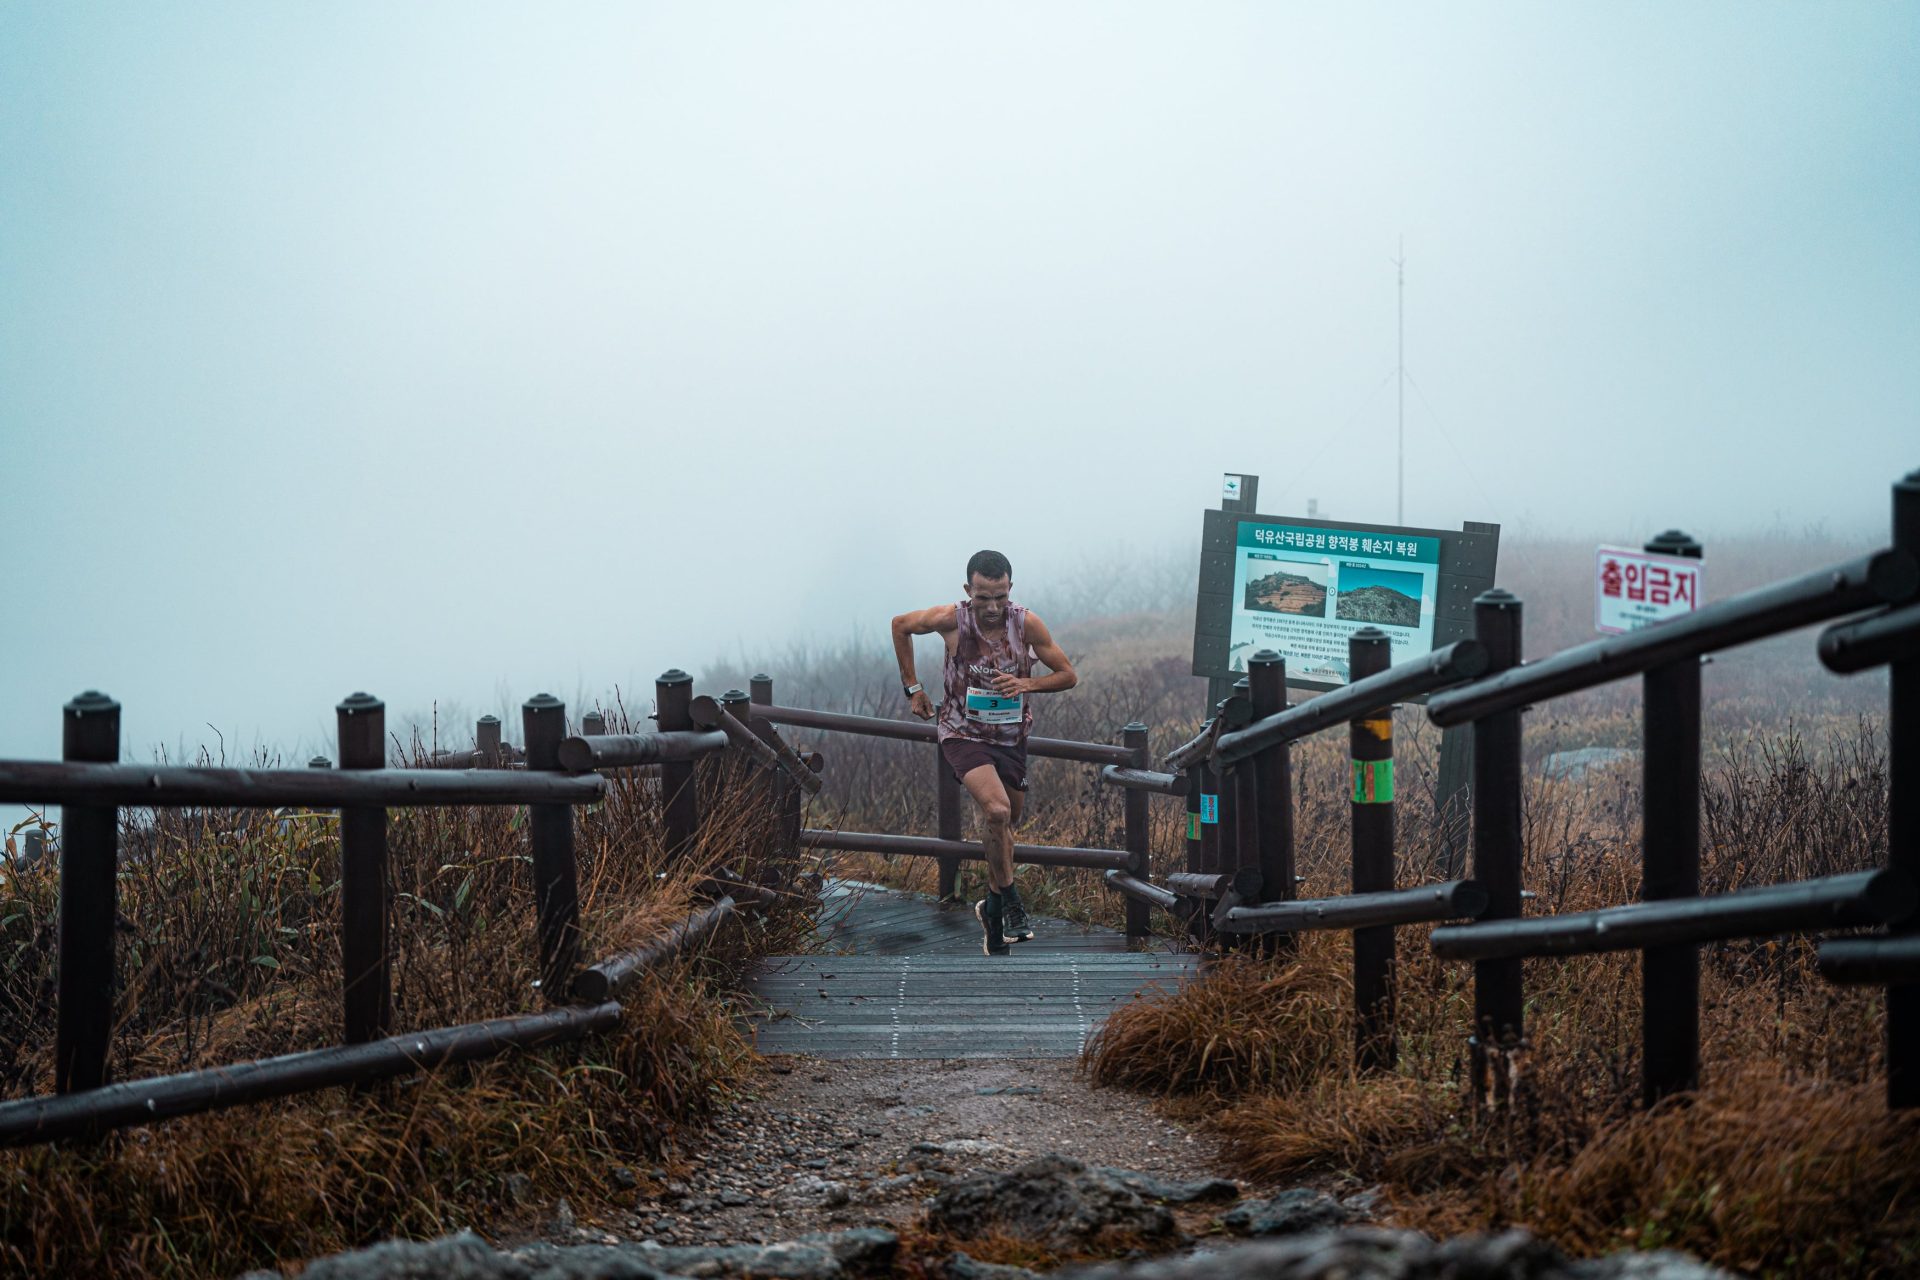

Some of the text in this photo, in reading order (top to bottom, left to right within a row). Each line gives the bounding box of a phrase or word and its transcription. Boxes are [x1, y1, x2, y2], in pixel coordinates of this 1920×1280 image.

[1254, 529, 1418, 557] 덕유산국립공원 향적봉 훼손지 복원
[1600, 558, 1696, 612] 출입금지
[989, 699, 998, 708] 3
